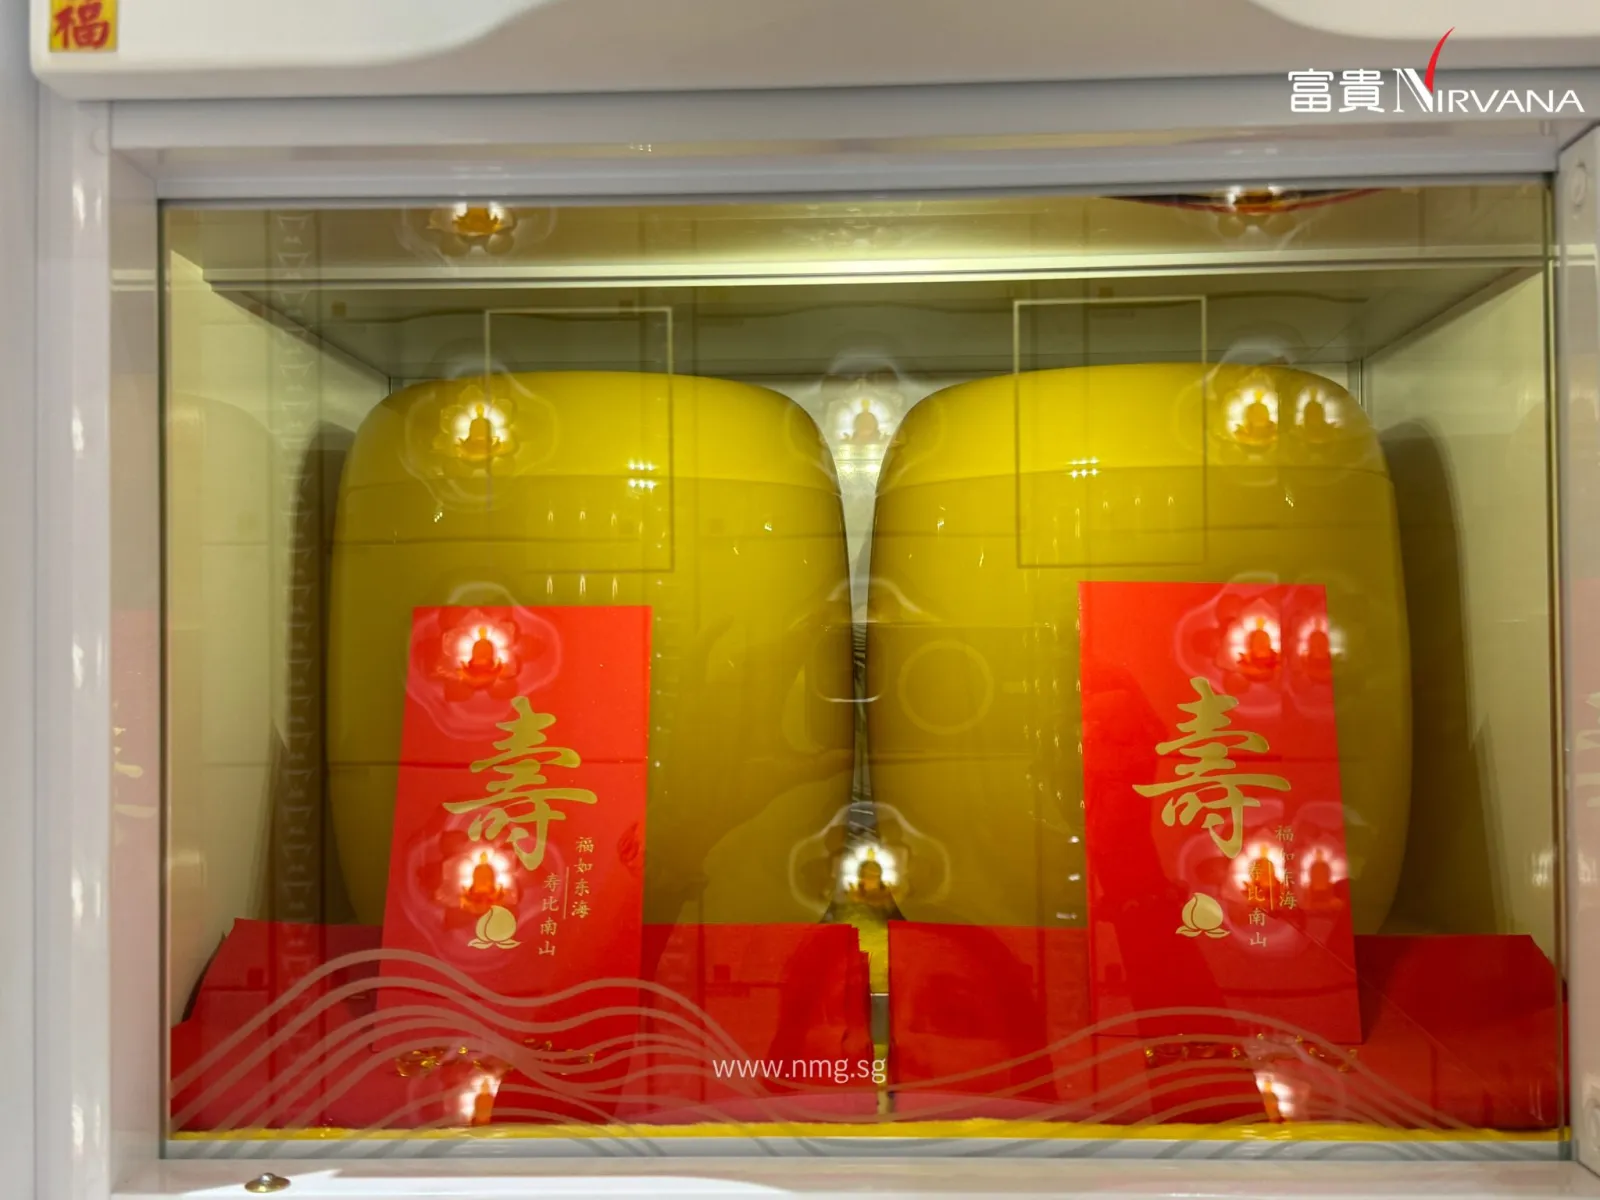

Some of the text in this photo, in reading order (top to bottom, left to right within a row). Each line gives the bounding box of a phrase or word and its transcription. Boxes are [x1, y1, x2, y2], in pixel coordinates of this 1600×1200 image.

[54, 0, 110, 50] 福
[537, 873, 561, 956] 寿比南山
[571, 836, 595, 919] 福如东海
